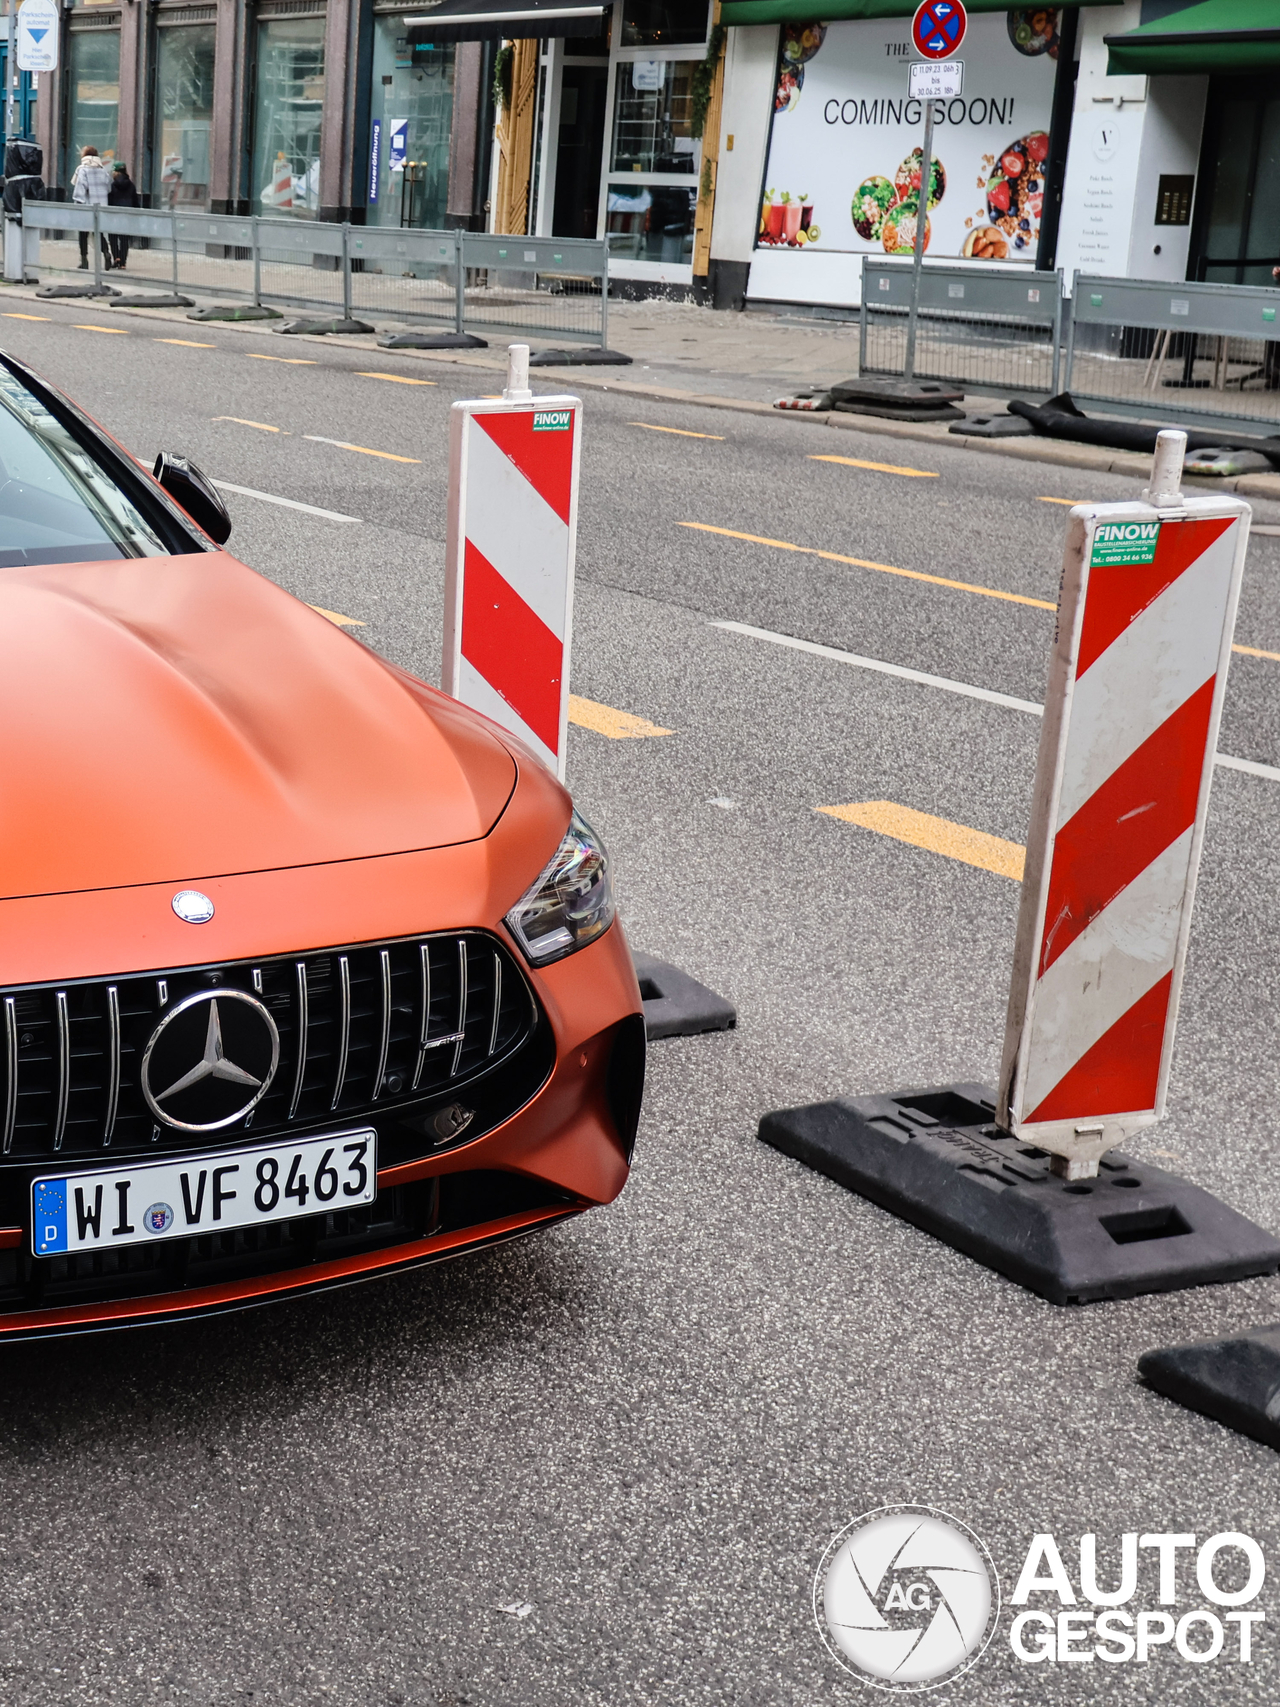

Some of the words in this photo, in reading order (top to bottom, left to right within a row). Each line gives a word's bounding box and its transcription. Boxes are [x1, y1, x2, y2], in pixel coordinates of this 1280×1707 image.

[885, 43, 910, 56] THE
[920, 65, 941, 74] 11.09.23
[943, 64, 955, 73] 06h
[917, 87, 942, 96] 30.06.25
[824, 99, 922, 125] COMING
[932, 98, 1015, 125] SOON!
[370, 124, 380, 199] Neueröffnung
[534, 413, 570, 425] FINOW
[1094, 523, 1160, 541] FINOW
[1093, 538, 1157, 547] BAUSTELLENABSICHERUNG
[74, 1180, 135, 1240] WI
[179, 1164, 240, 1225] VF
[254, 1140, 368, 1212] 8463
[45, 1225, 57, 1241] D
